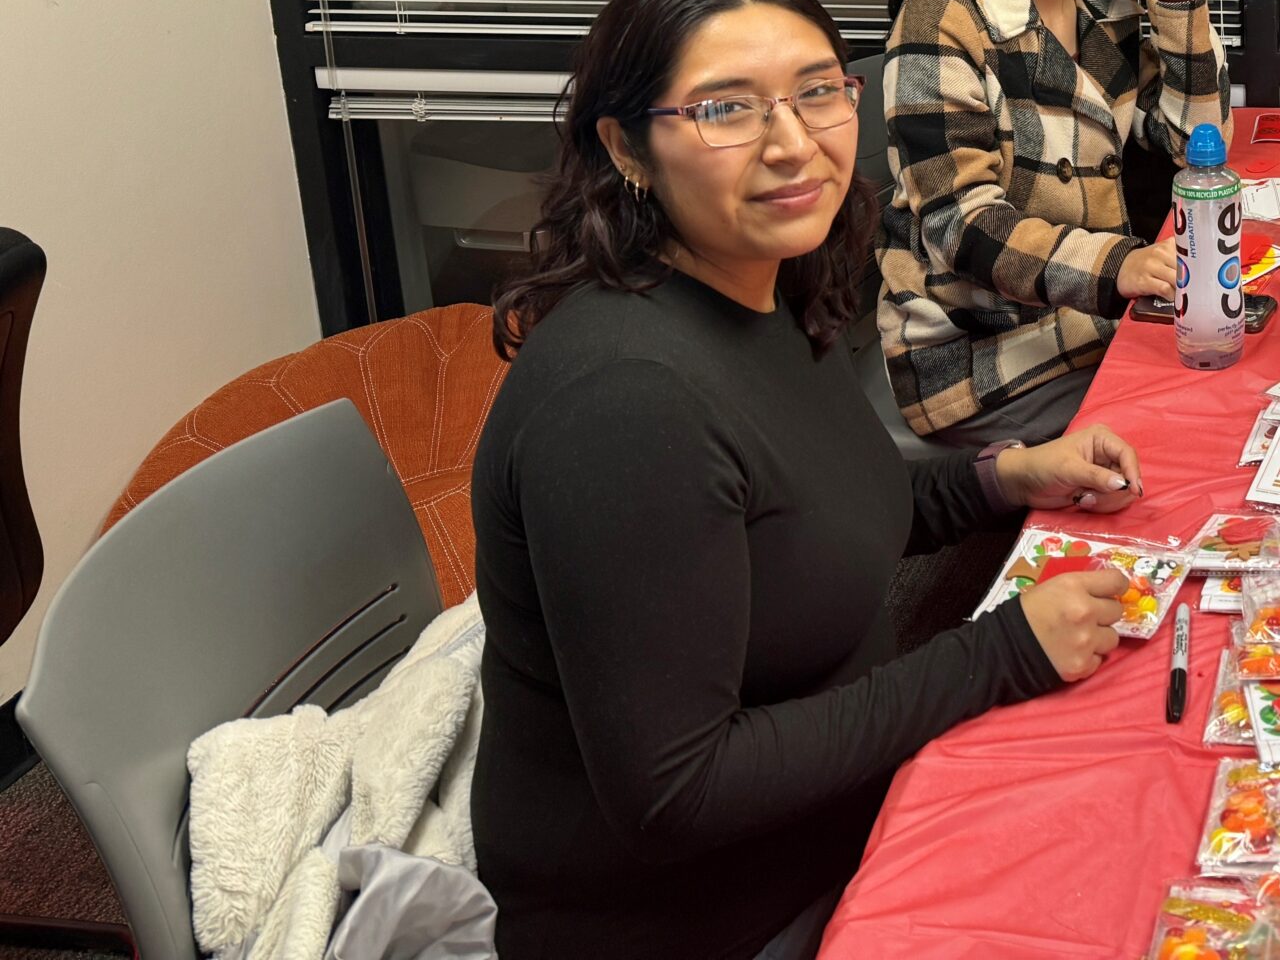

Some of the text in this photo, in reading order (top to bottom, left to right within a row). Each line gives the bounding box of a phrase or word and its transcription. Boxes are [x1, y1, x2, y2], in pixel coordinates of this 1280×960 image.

[1196, 191, 1218, 199] RECYCLED
[1218, 187, 1234, 197] PLASTIC
[1190, 208, 1198, 259] HYDRATION
[1217, 201, 1243, 320] core
